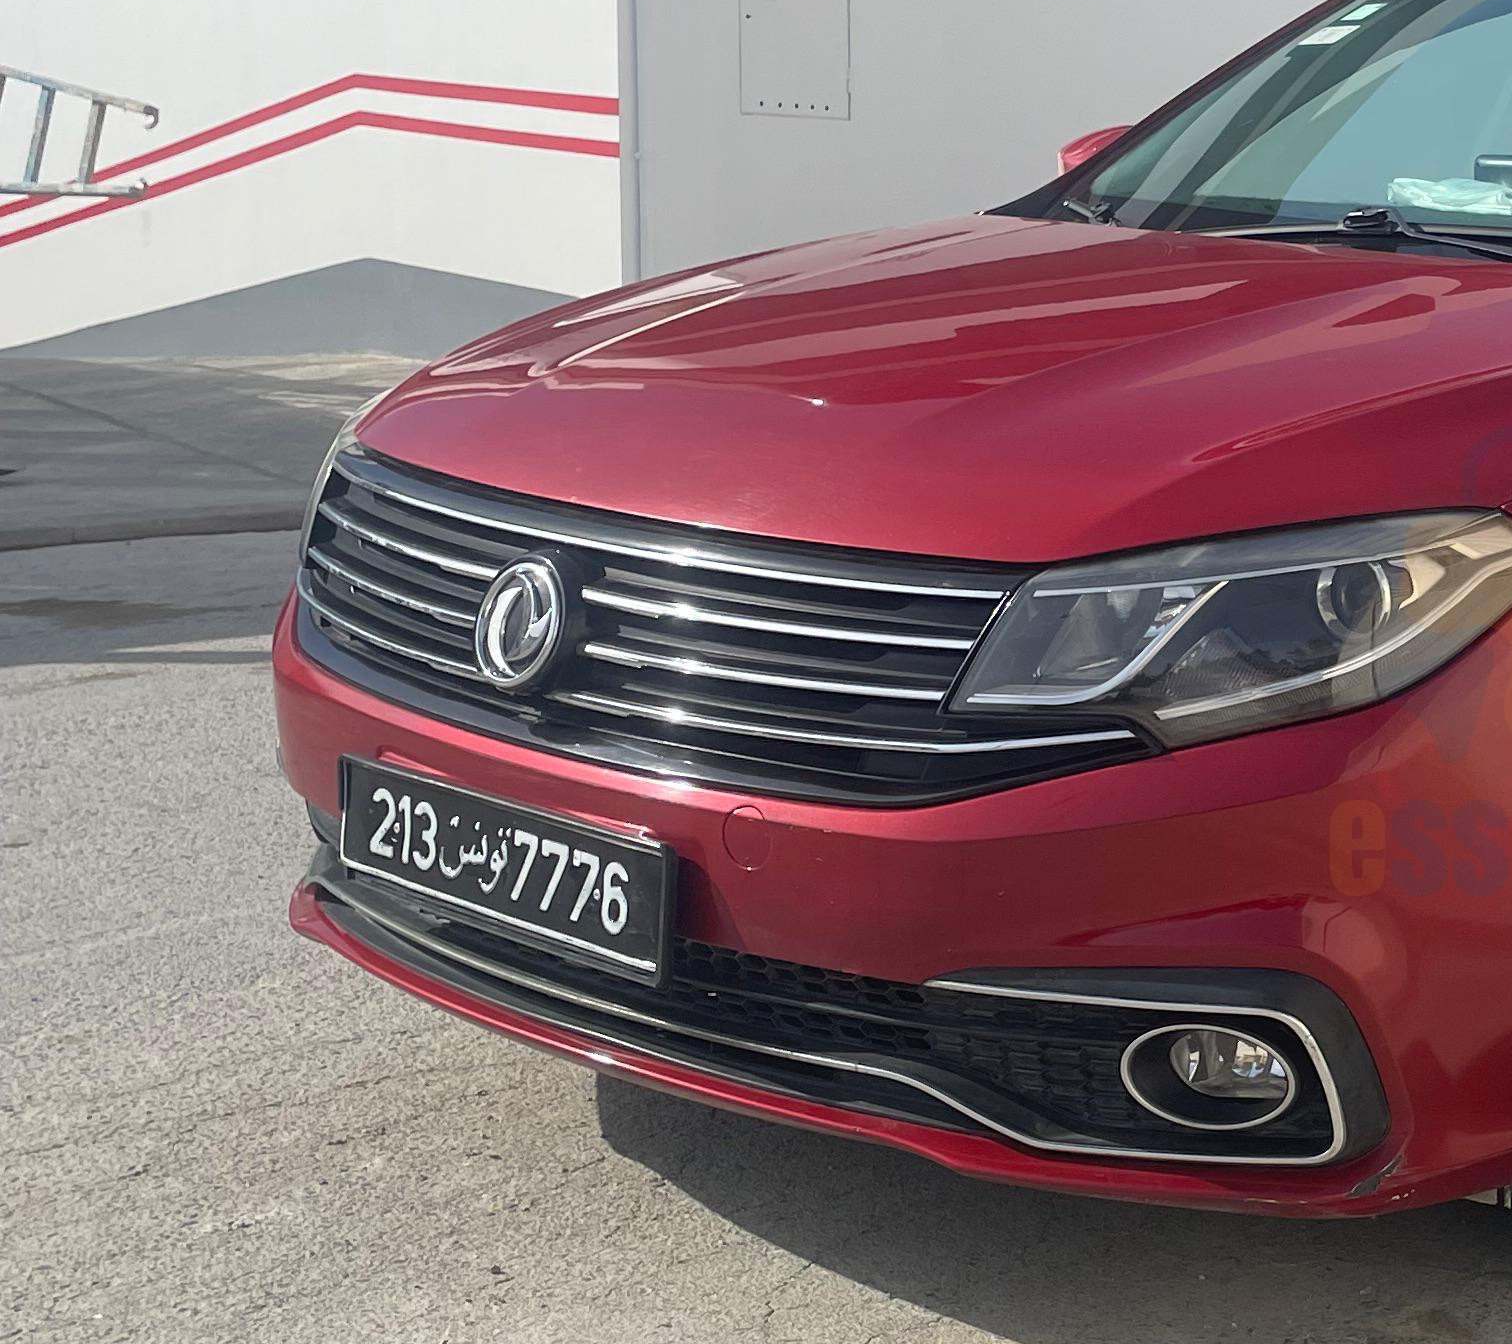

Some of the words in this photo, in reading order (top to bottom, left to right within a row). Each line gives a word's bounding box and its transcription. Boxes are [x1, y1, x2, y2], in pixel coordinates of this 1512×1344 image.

[369, 787, 438, 871] 213
[438, 814, 512, 895] تونس
[509, 830, 630, 936] 7776
